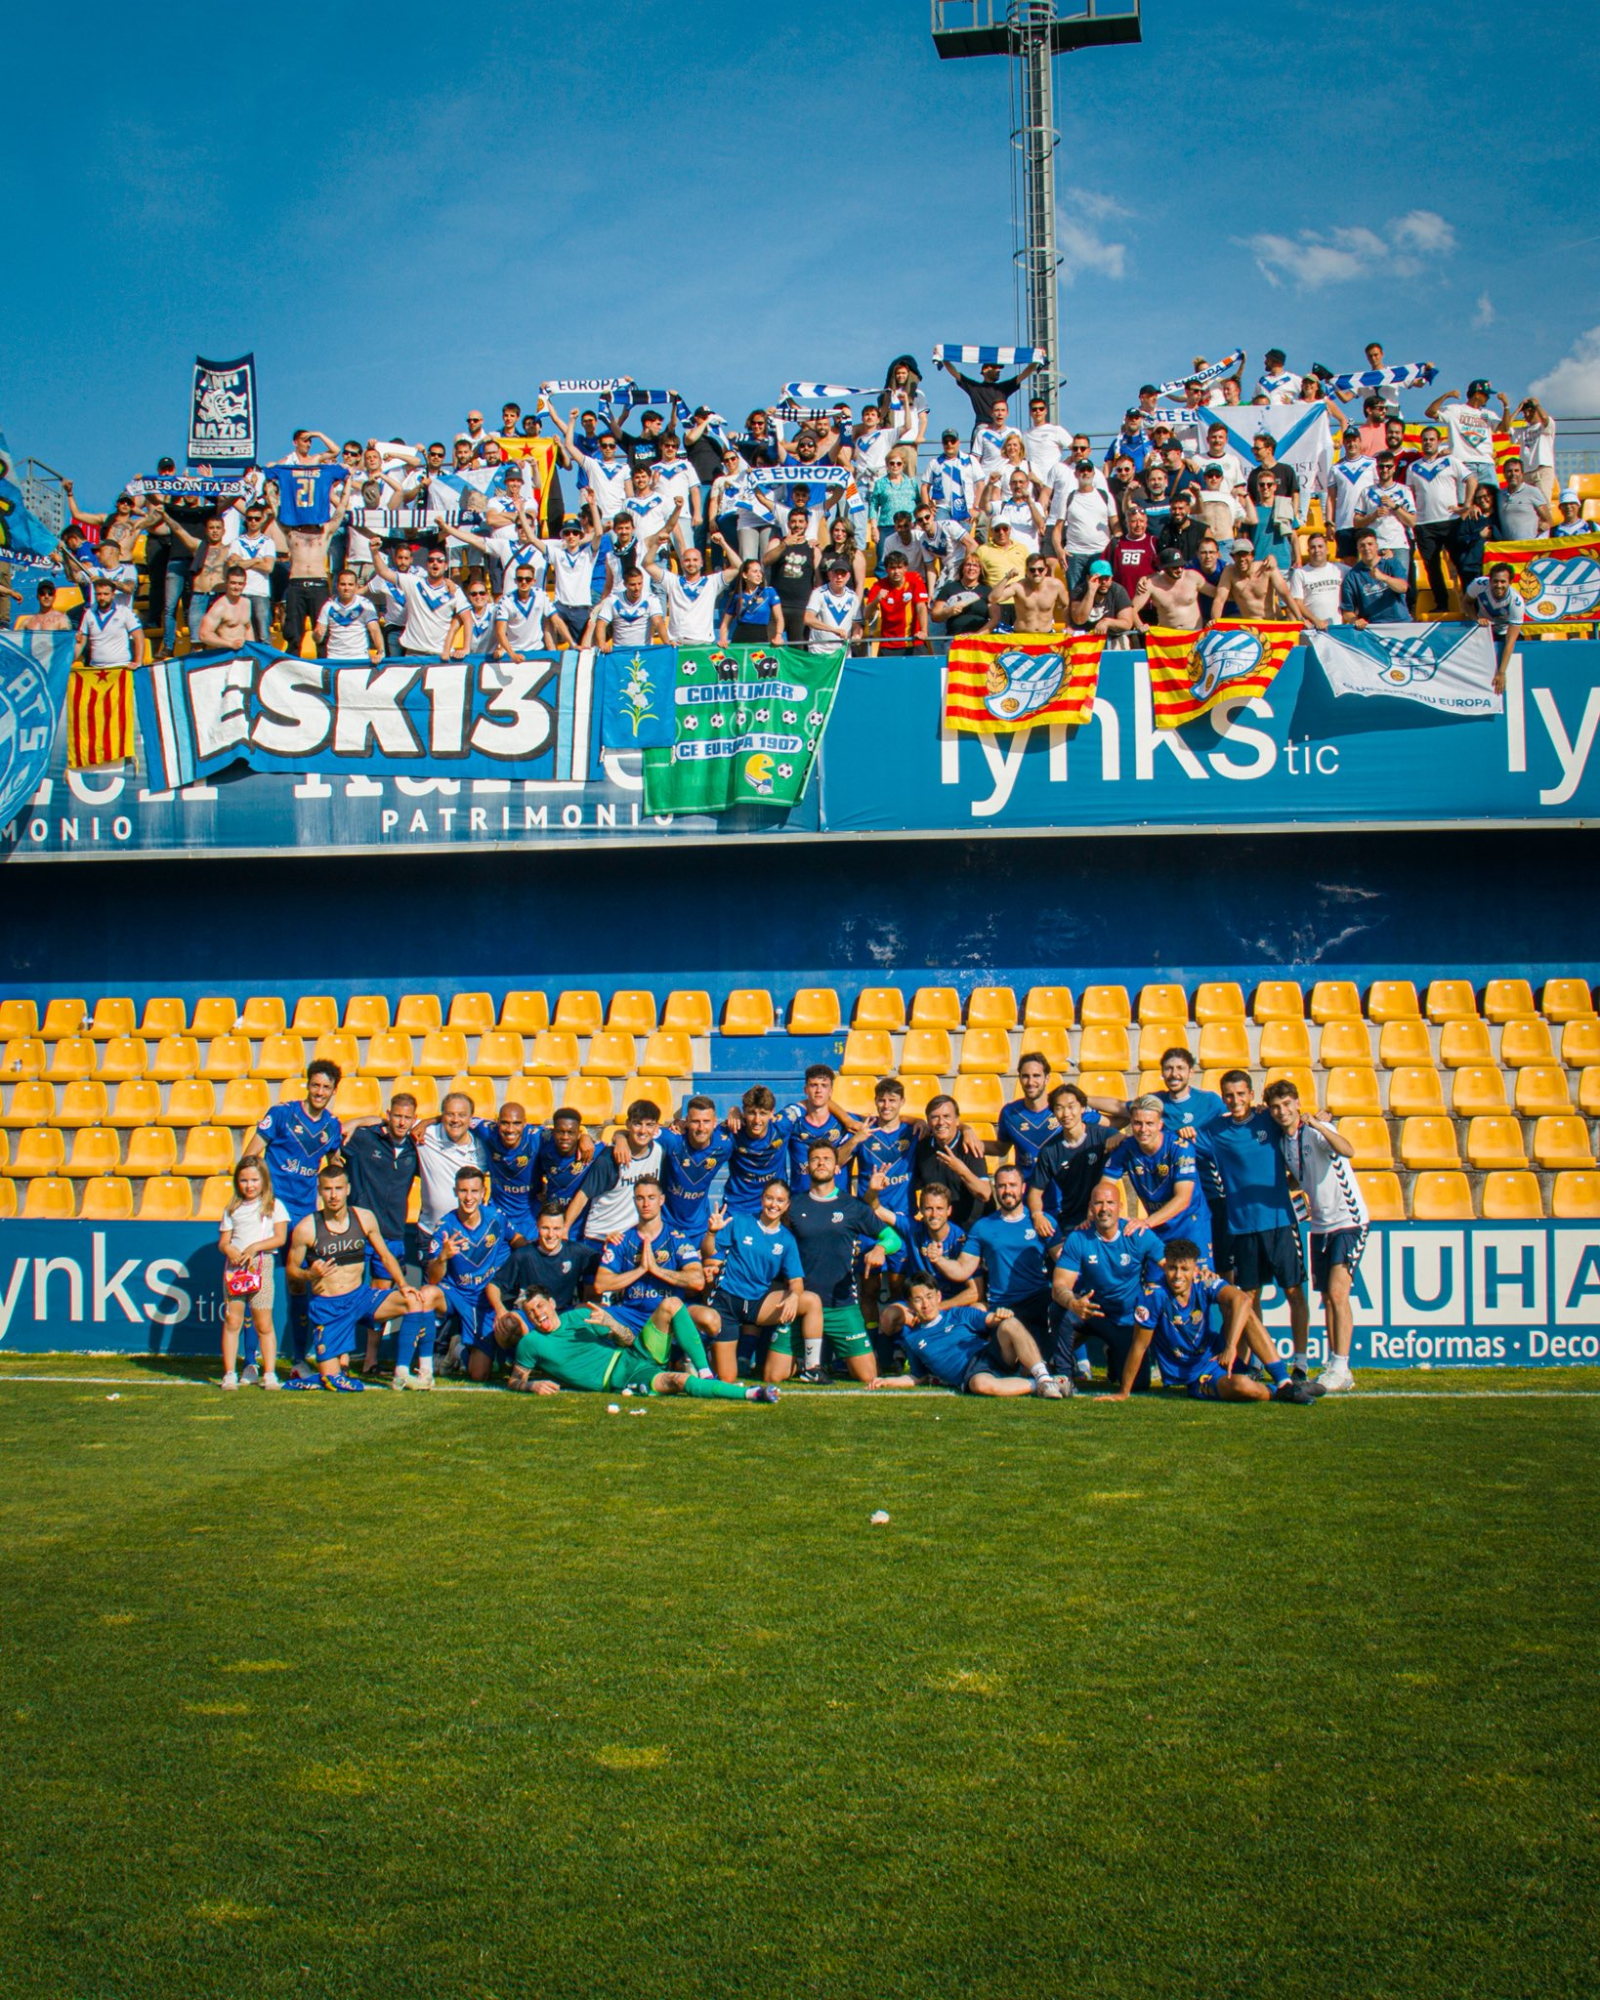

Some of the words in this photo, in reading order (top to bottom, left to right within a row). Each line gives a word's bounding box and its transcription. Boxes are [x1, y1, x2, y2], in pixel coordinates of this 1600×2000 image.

[558, 378, 619, 391] EUROPA
[195, 422, 247, 438] NAZIS
[771, 467, 851, 485] EUROPA
[296, 478, 315, 507] 21
[1122, 552, 1141, 565] 89
[187, 655, 558, 761] ESK13
[1439, 698, 1492, 708] EUROPA
[680, 743, 698, 757] CE
[760, 736, 799, 750] 1907
[1283, 735, 1340, 774] tic
[1371, 1330, 1505, 1359] Reformas
[1529, 1330, 1599, 1358] Deco
